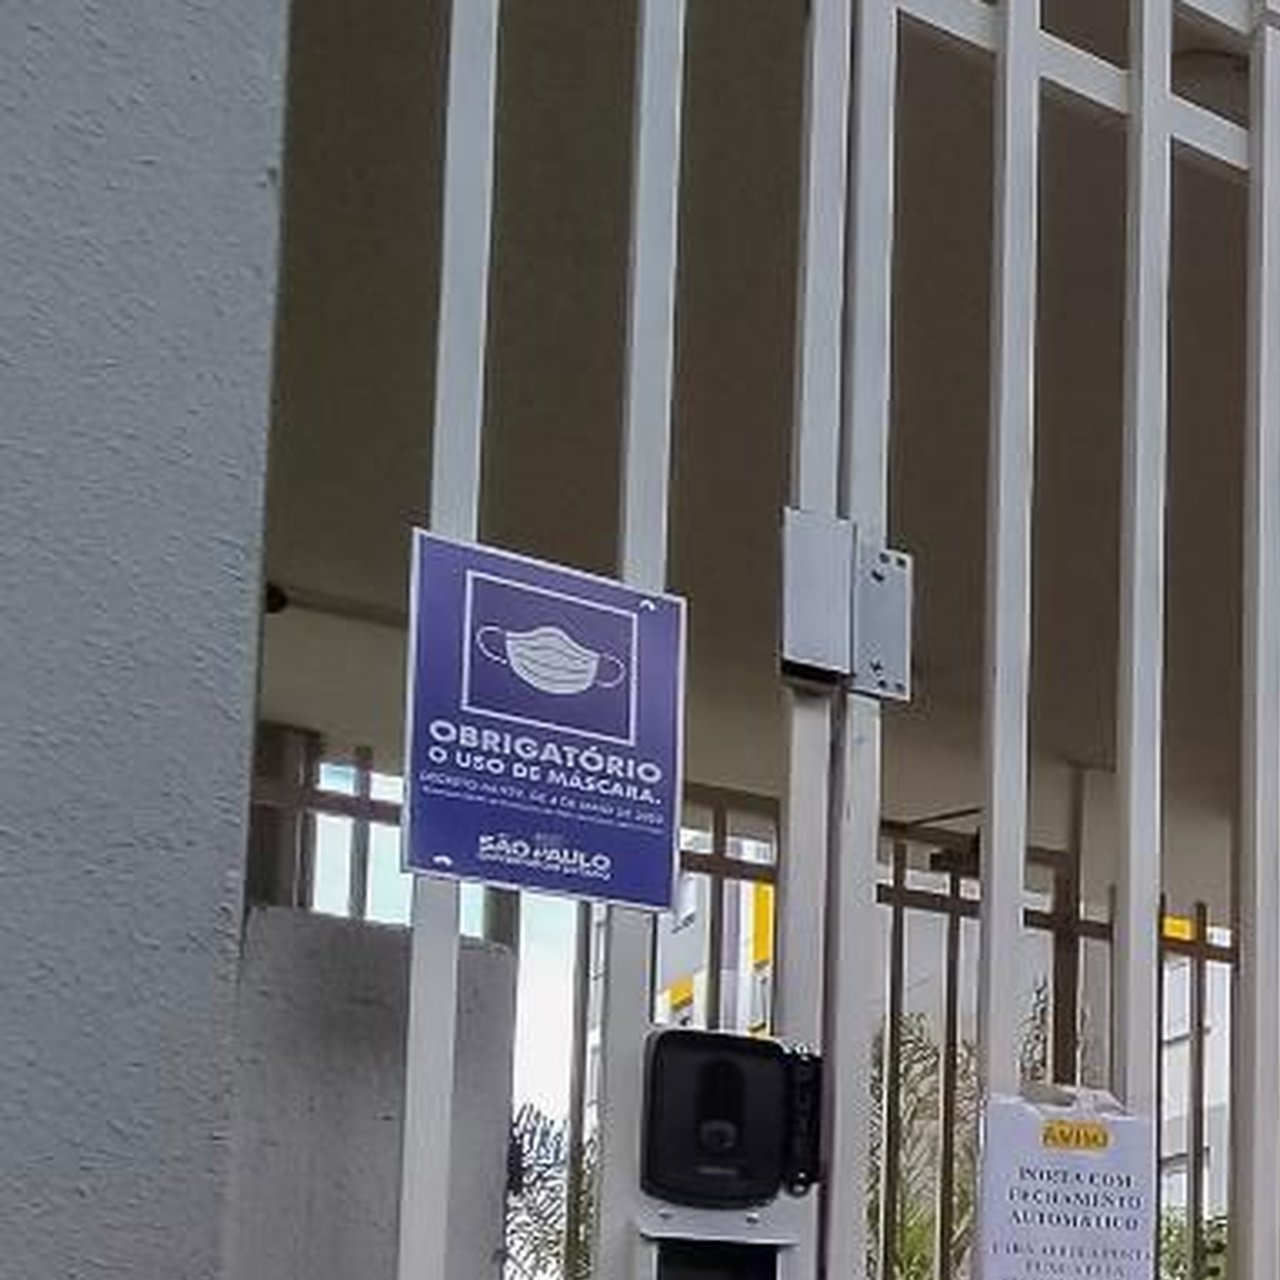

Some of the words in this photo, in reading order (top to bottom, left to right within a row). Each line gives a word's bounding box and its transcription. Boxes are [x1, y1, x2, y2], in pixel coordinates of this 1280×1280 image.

[428, 719, 663, 783] OBRIGATÓRIO
[428, 745, 448, 763] O
[455, 750, 505, 775] USO
[512, 763, 541, 782] DE
[479, 832, 530, 858] SÃO
